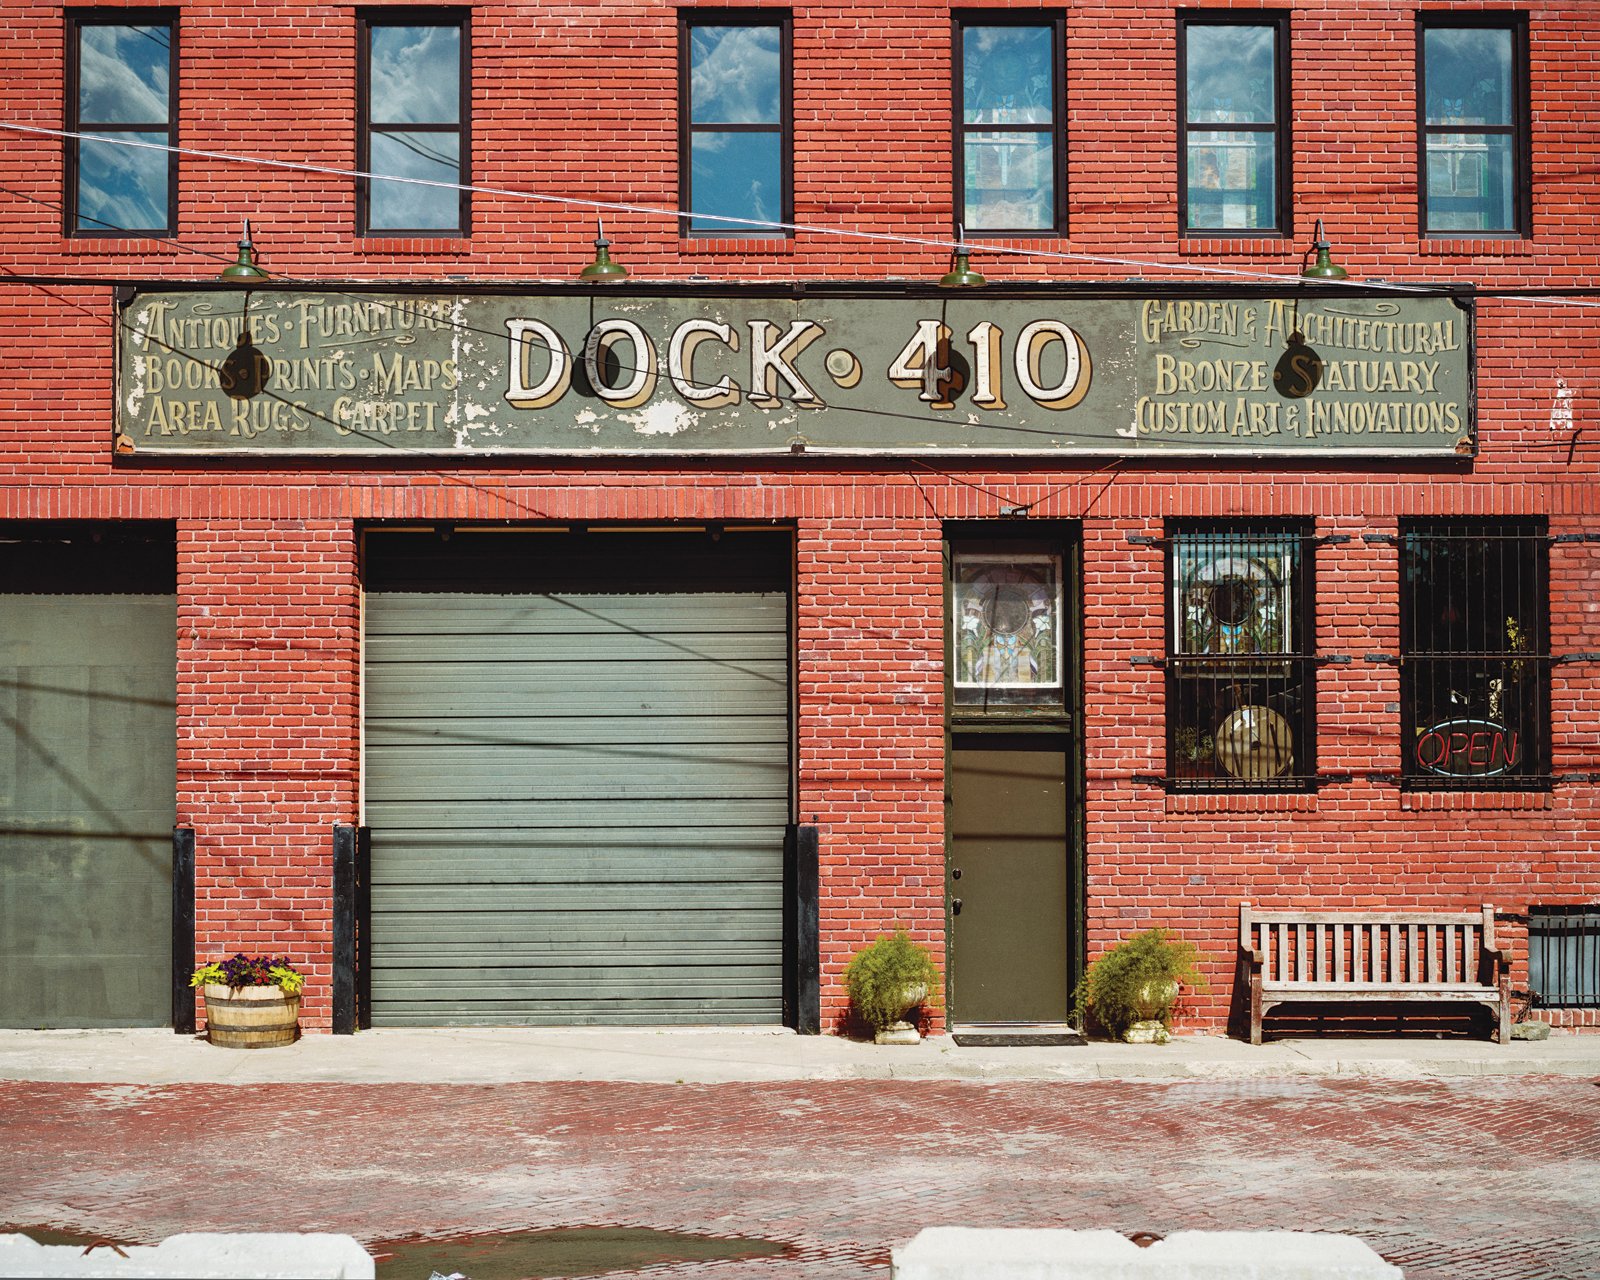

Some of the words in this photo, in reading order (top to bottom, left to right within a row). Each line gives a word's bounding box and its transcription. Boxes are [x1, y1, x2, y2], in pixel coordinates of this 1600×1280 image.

[143, 302, 282, 353] ANTIQUES
[292, 298, 455, 349] FURNITURE
[1142, 299, 1238, 344] GARDEN
[1264, 298, 1459, 355] ARCHITECTURAL
[145, 355, 237, 394] BOOKS
[254, 354, 357, 393] PRINTS
[372, 352, 458, 395] MAPS
[503, 318, 826, 410] DOCK
[888, 319, 1093, 411] 410
[1155, 354, 1269, 396] BRONZE
[1289, 354, 1441, 397] STATUARY
[145, 396, 225, 436] AREA
[230, 395, 312, 439] RUGS
[332, 396, 440, 436] CARPET
[1136, 396, 1227, 435] CUSTOM
[1231, 397, 1284, 437] ART
[1304, 398, 1462, 438] INNOVATIONS
[1417, 731, 1519, 767] OPEN
